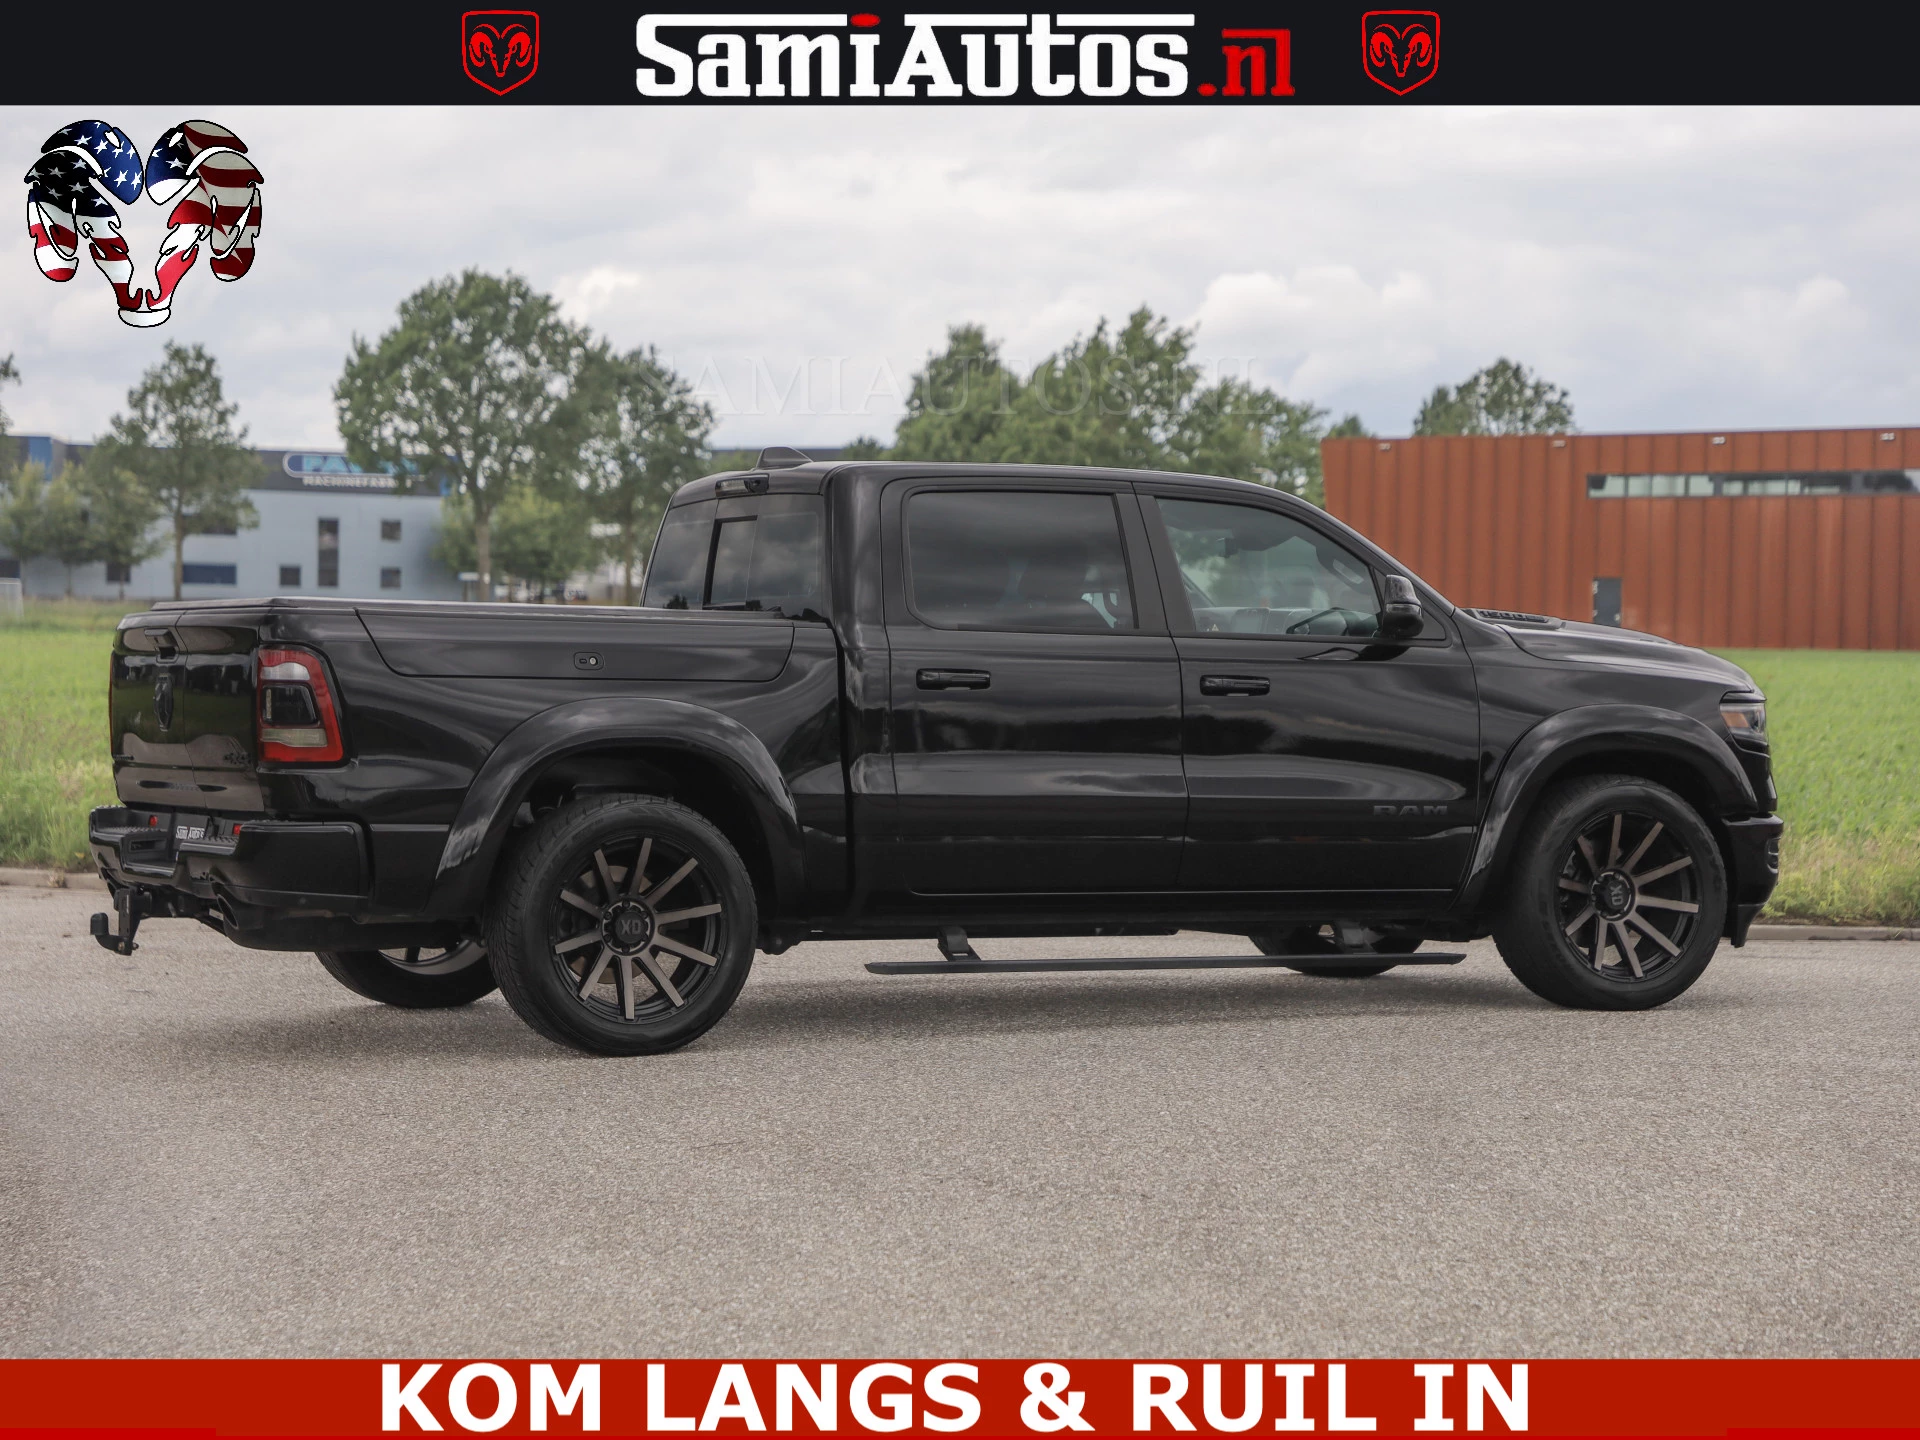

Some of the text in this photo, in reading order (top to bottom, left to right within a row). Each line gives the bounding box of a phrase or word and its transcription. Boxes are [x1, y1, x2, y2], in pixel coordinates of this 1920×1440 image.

[1373, 805, 1448, 816] RAM
[1611, 886, 1624, 905] XD
[621, 919, 642, 935] XD
